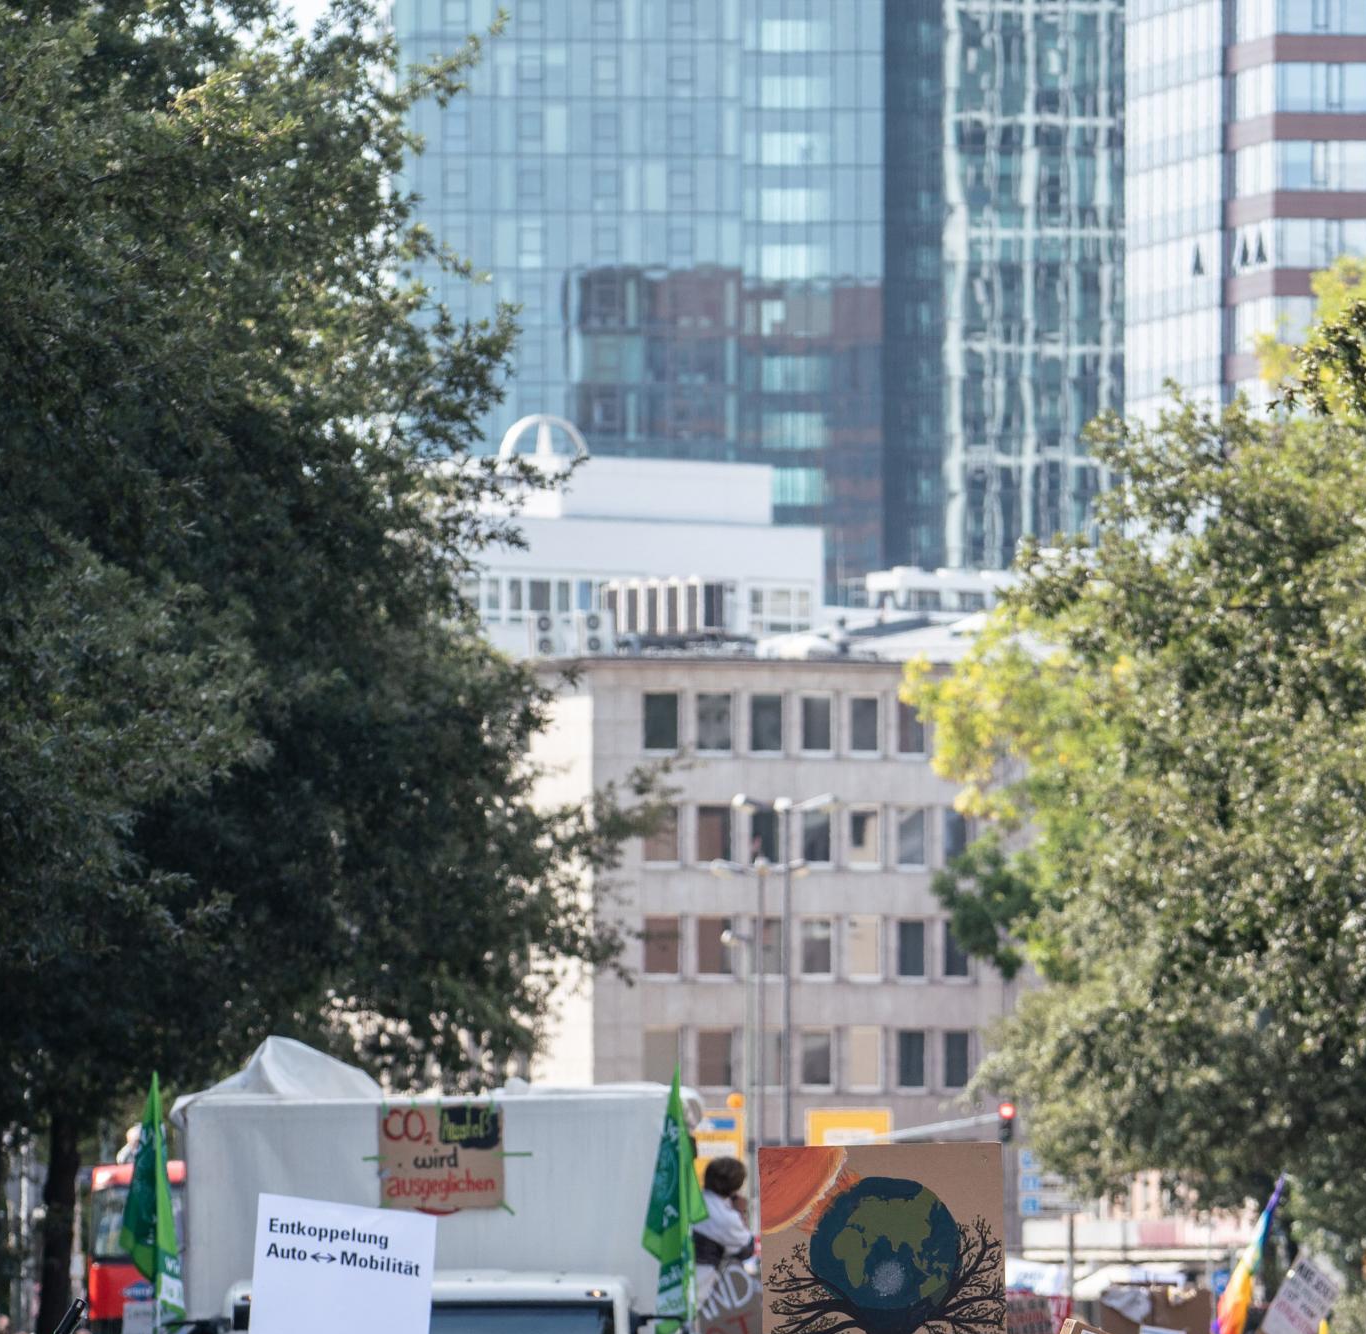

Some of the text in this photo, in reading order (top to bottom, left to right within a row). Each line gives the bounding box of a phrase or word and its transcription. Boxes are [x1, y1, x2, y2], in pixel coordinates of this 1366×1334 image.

[413, 1146, 459, 1168] wird
[268, 1217, 389, 1250] Entkoppelung
[266, 1242, 420, 1278] Auto Mobilität
